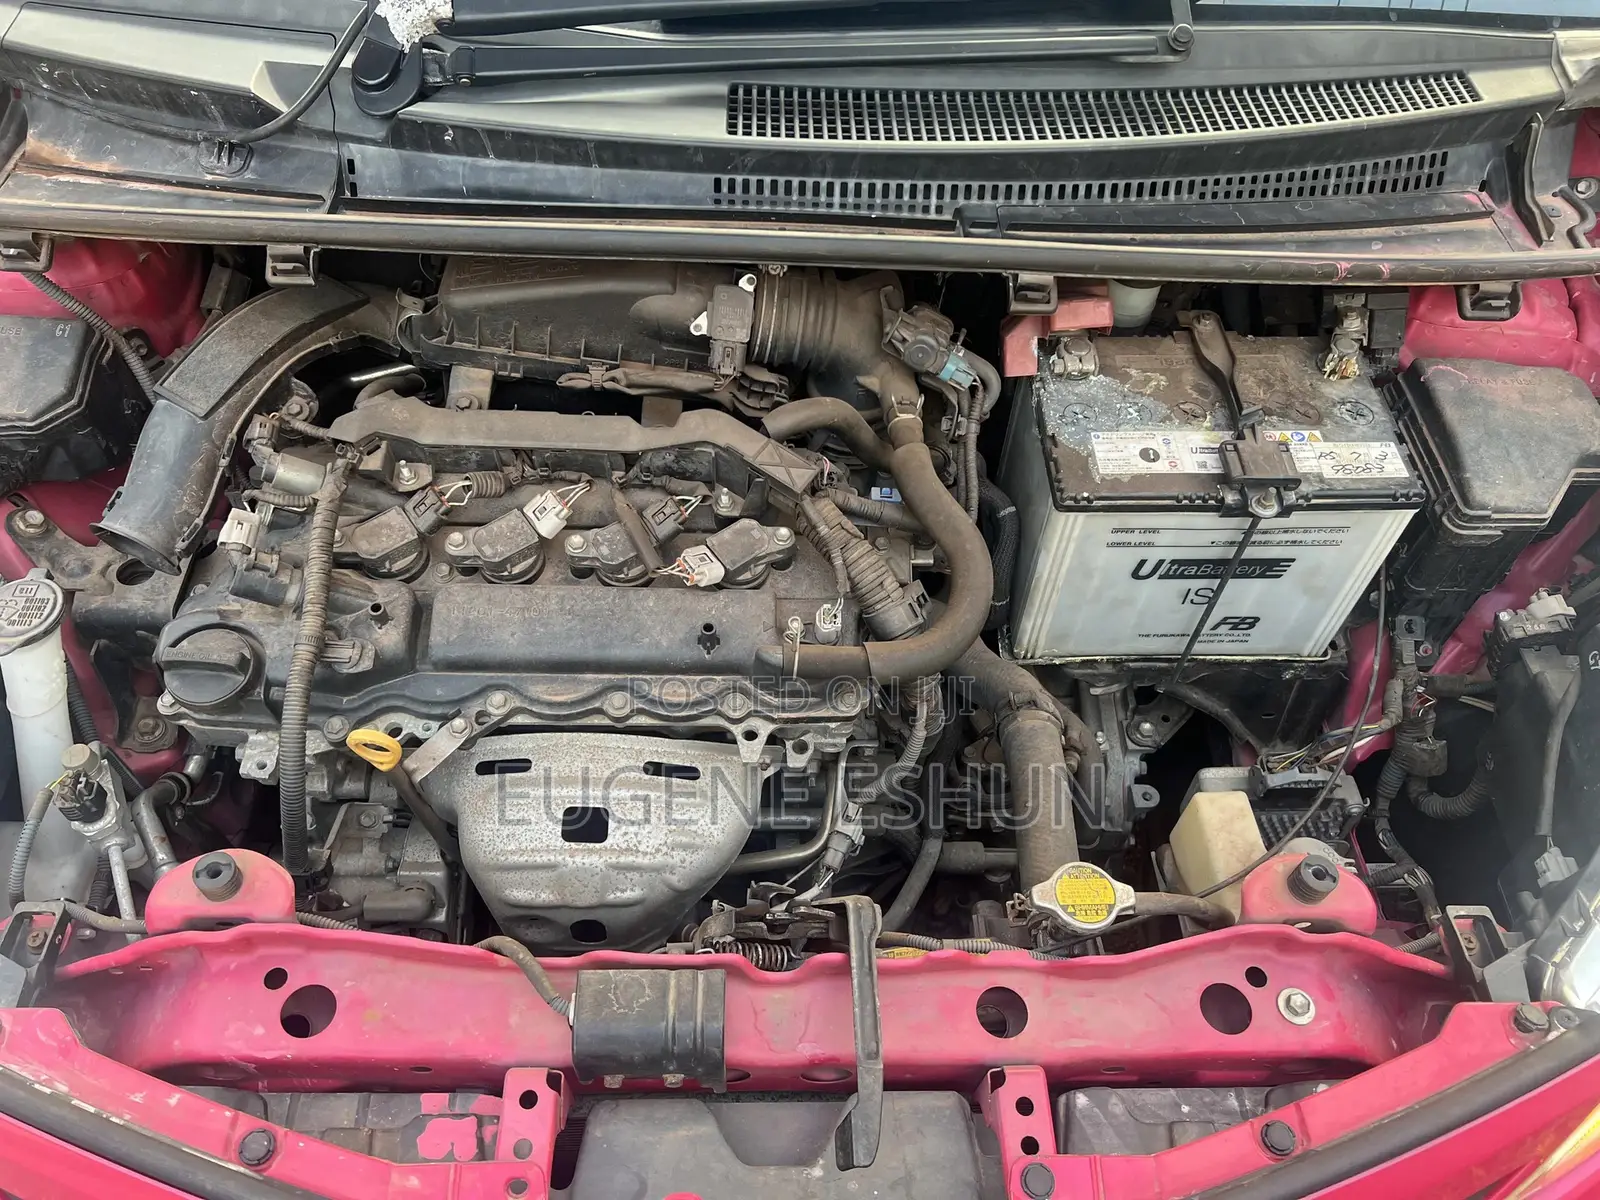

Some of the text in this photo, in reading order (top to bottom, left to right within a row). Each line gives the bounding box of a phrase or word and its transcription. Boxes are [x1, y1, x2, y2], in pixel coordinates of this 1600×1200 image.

[0, 327, 23, 336] USE
[1131, 559, 1267, 580] UltraBaery
[1181, 587, 1215, 605] IS
[1210, 616, 1261, 631] FB
[166, 651, 196, 660] ENGINE
